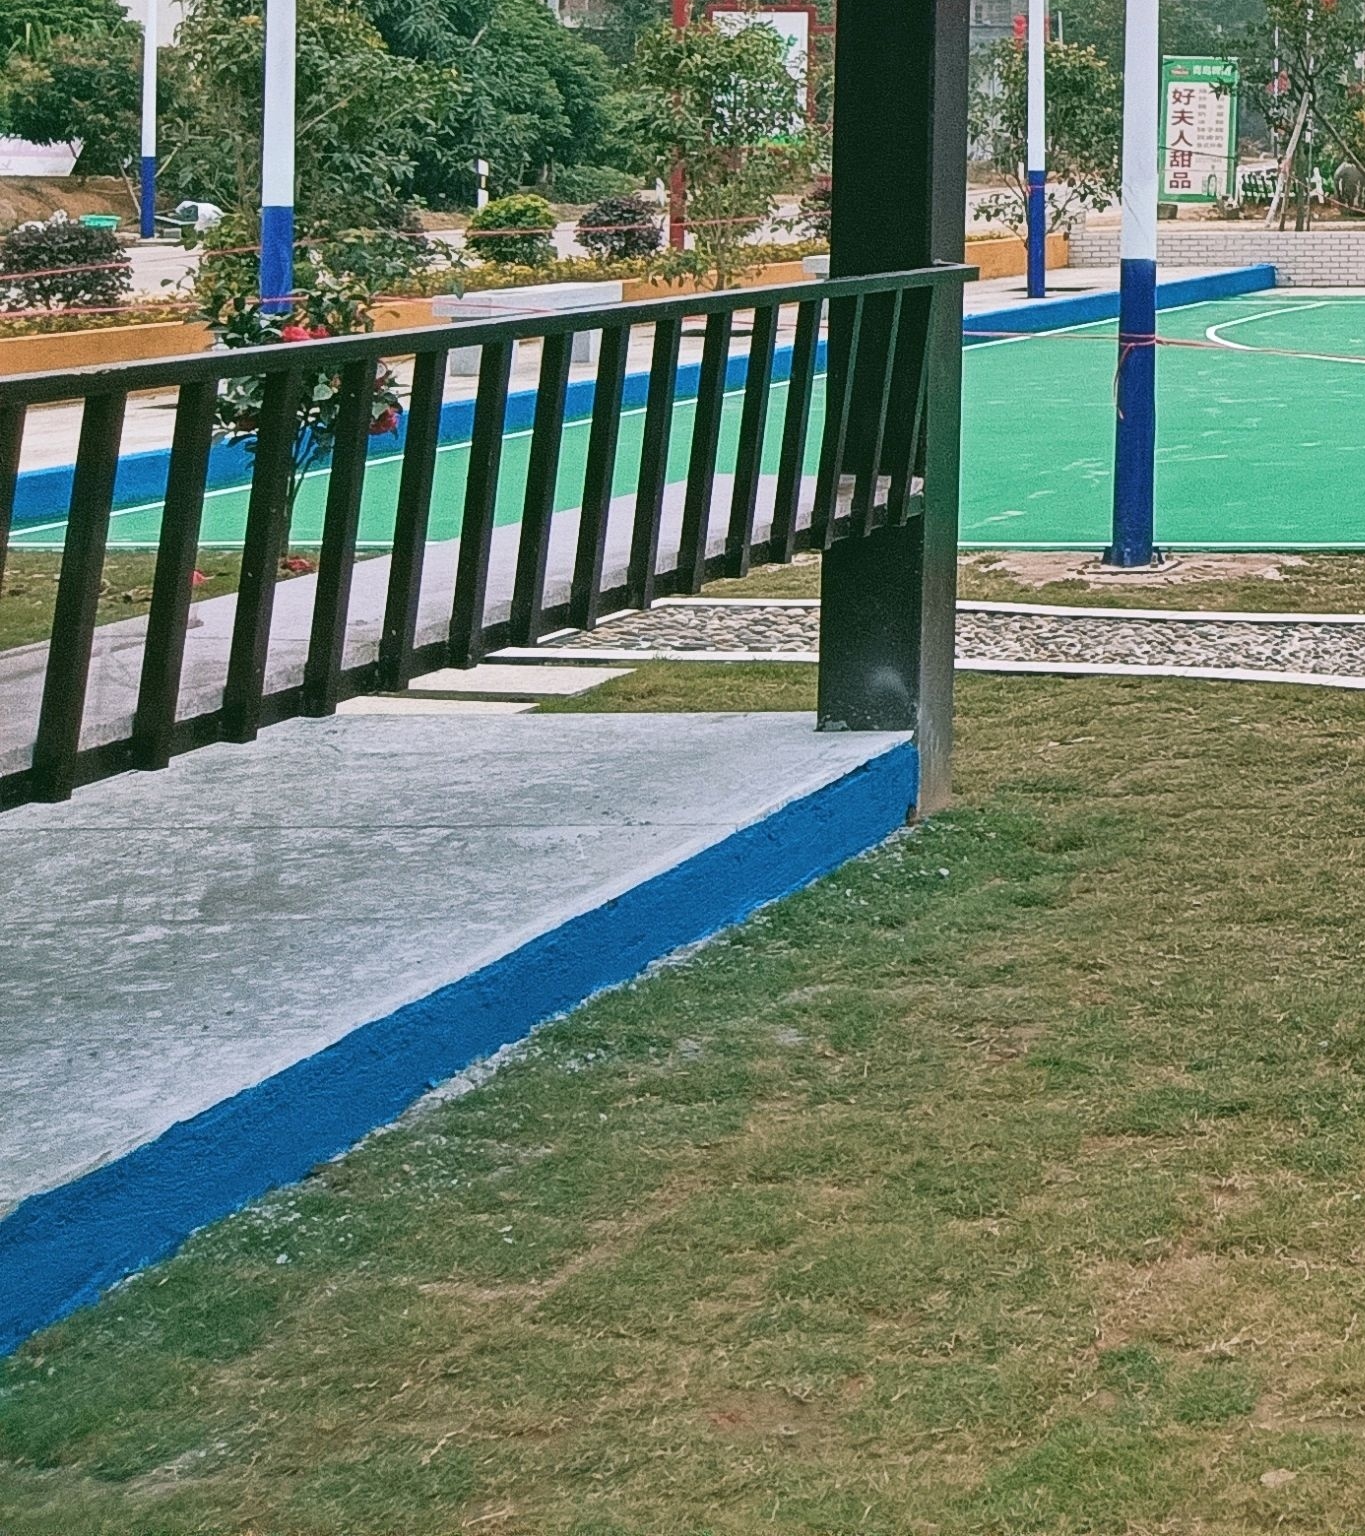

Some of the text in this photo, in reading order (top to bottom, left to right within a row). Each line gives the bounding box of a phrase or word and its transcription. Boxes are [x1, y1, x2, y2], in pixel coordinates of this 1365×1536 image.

[1169, 88, 1195, 189] 好夫人甜品
